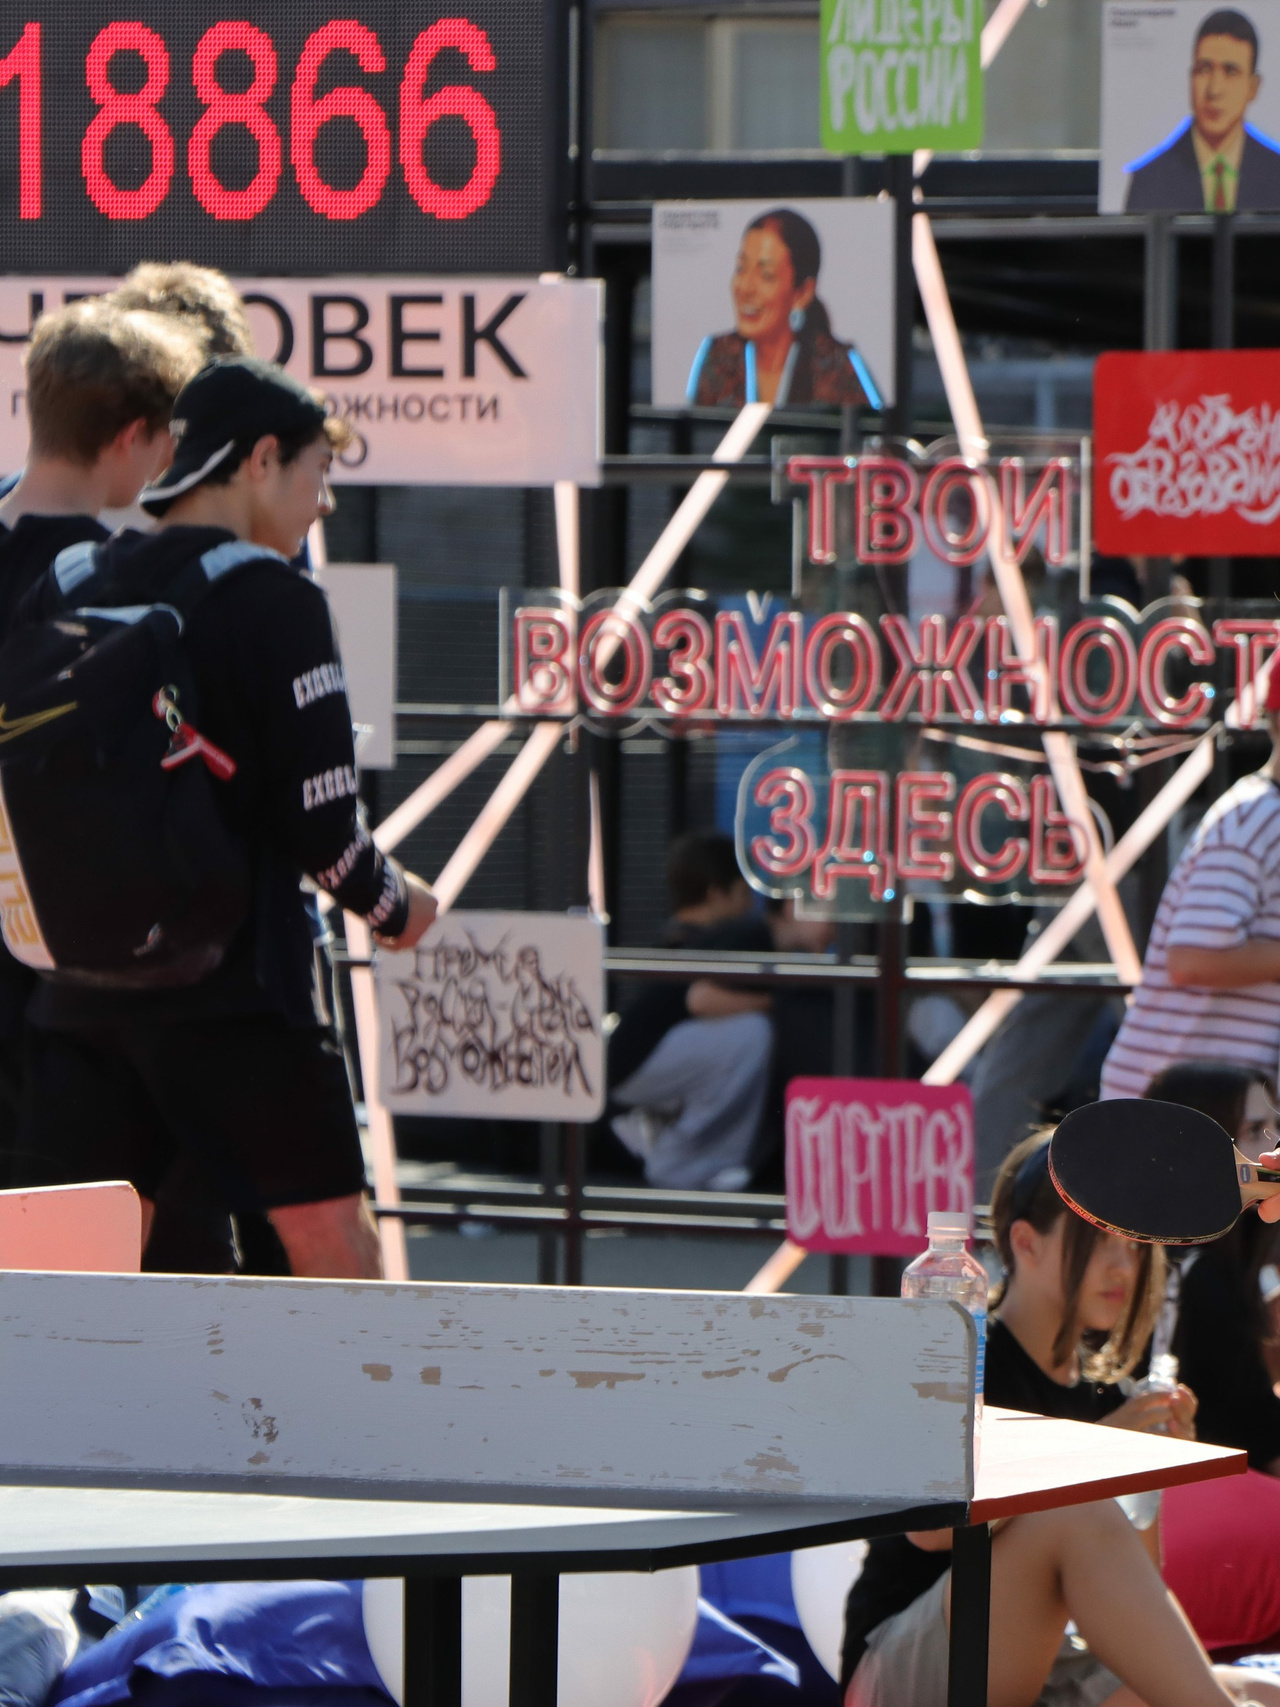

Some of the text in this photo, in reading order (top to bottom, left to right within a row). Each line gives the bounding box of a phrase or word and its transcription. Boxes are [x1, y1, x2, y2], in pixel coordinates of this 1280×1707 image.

[0, 19, 500, 220] 18866
[827, 45, 968, 135] РОССИИ
[751, 766, 1091, 901] ЗДЕСЬ
